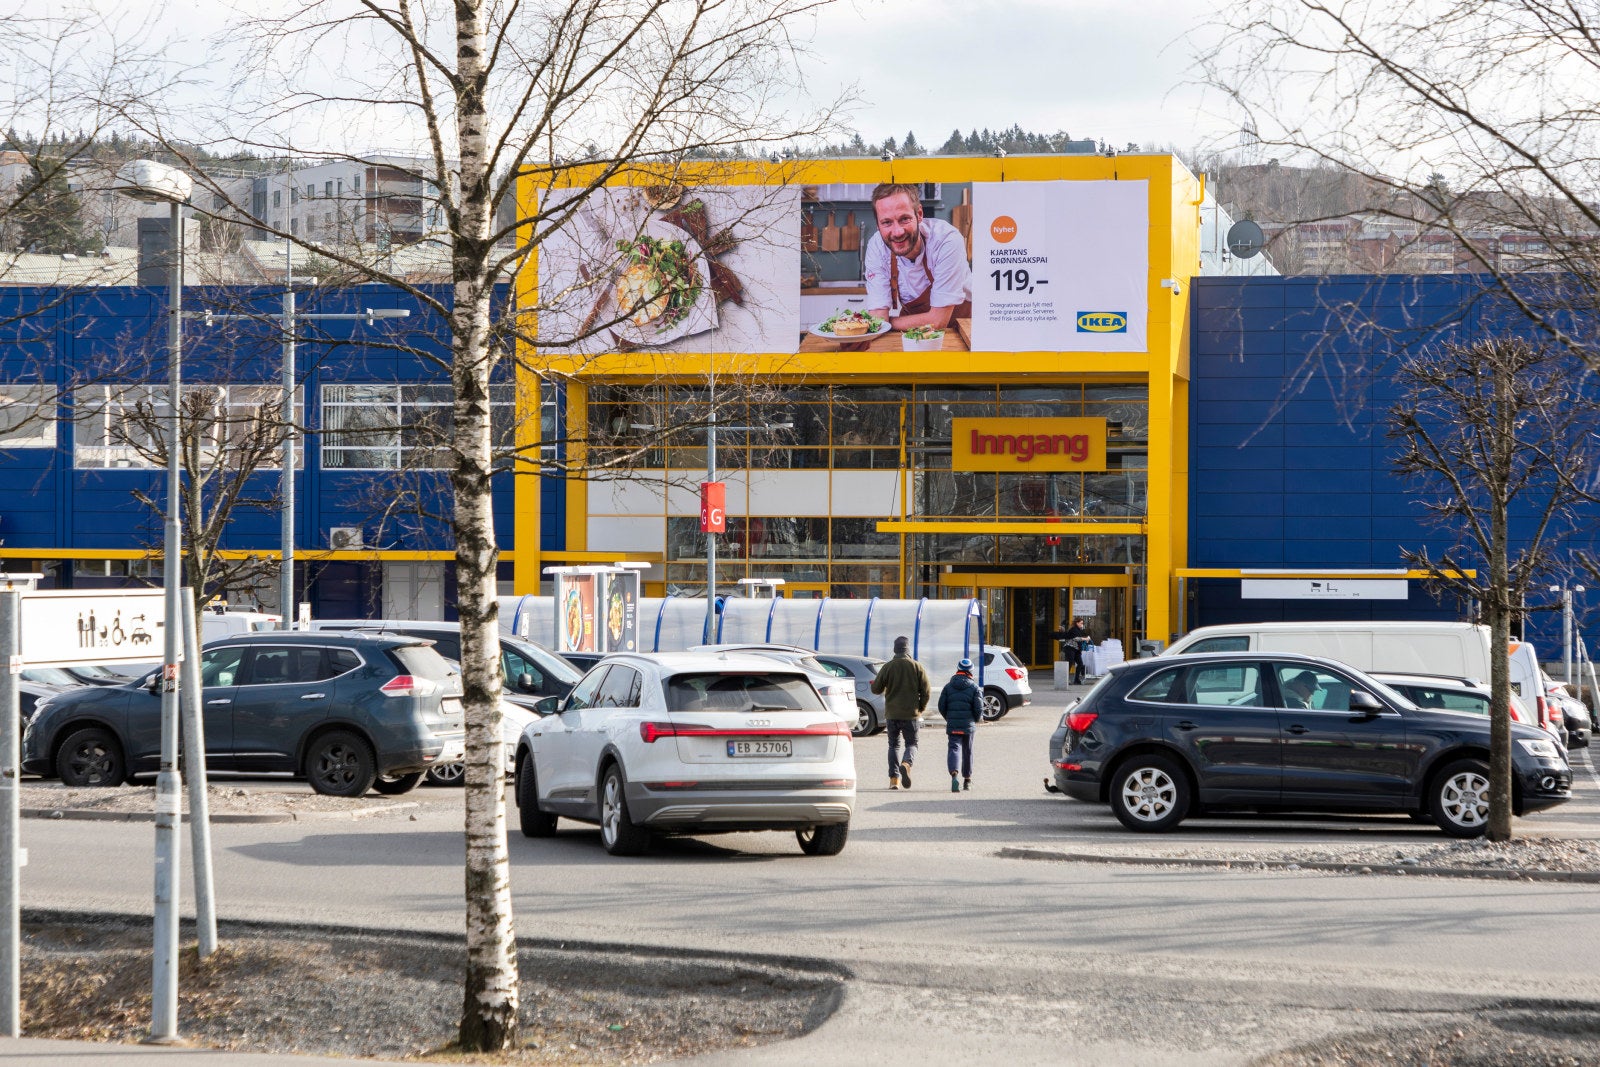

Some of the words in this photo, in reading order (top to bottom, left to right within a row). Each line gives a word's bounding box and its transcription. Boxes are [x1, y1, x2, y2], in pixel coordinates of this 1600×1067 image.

[993, 226, 1015, 235] Nyhet
[1081, 317, 1123, 327] IKEA
[971, 429, 1089, 462] Inngang
[701, 508, 707, 525] G
[711, 508, 722, 526] G
[737, 743, 751, 753] EB
[756, 743, 788, 753] 25706
